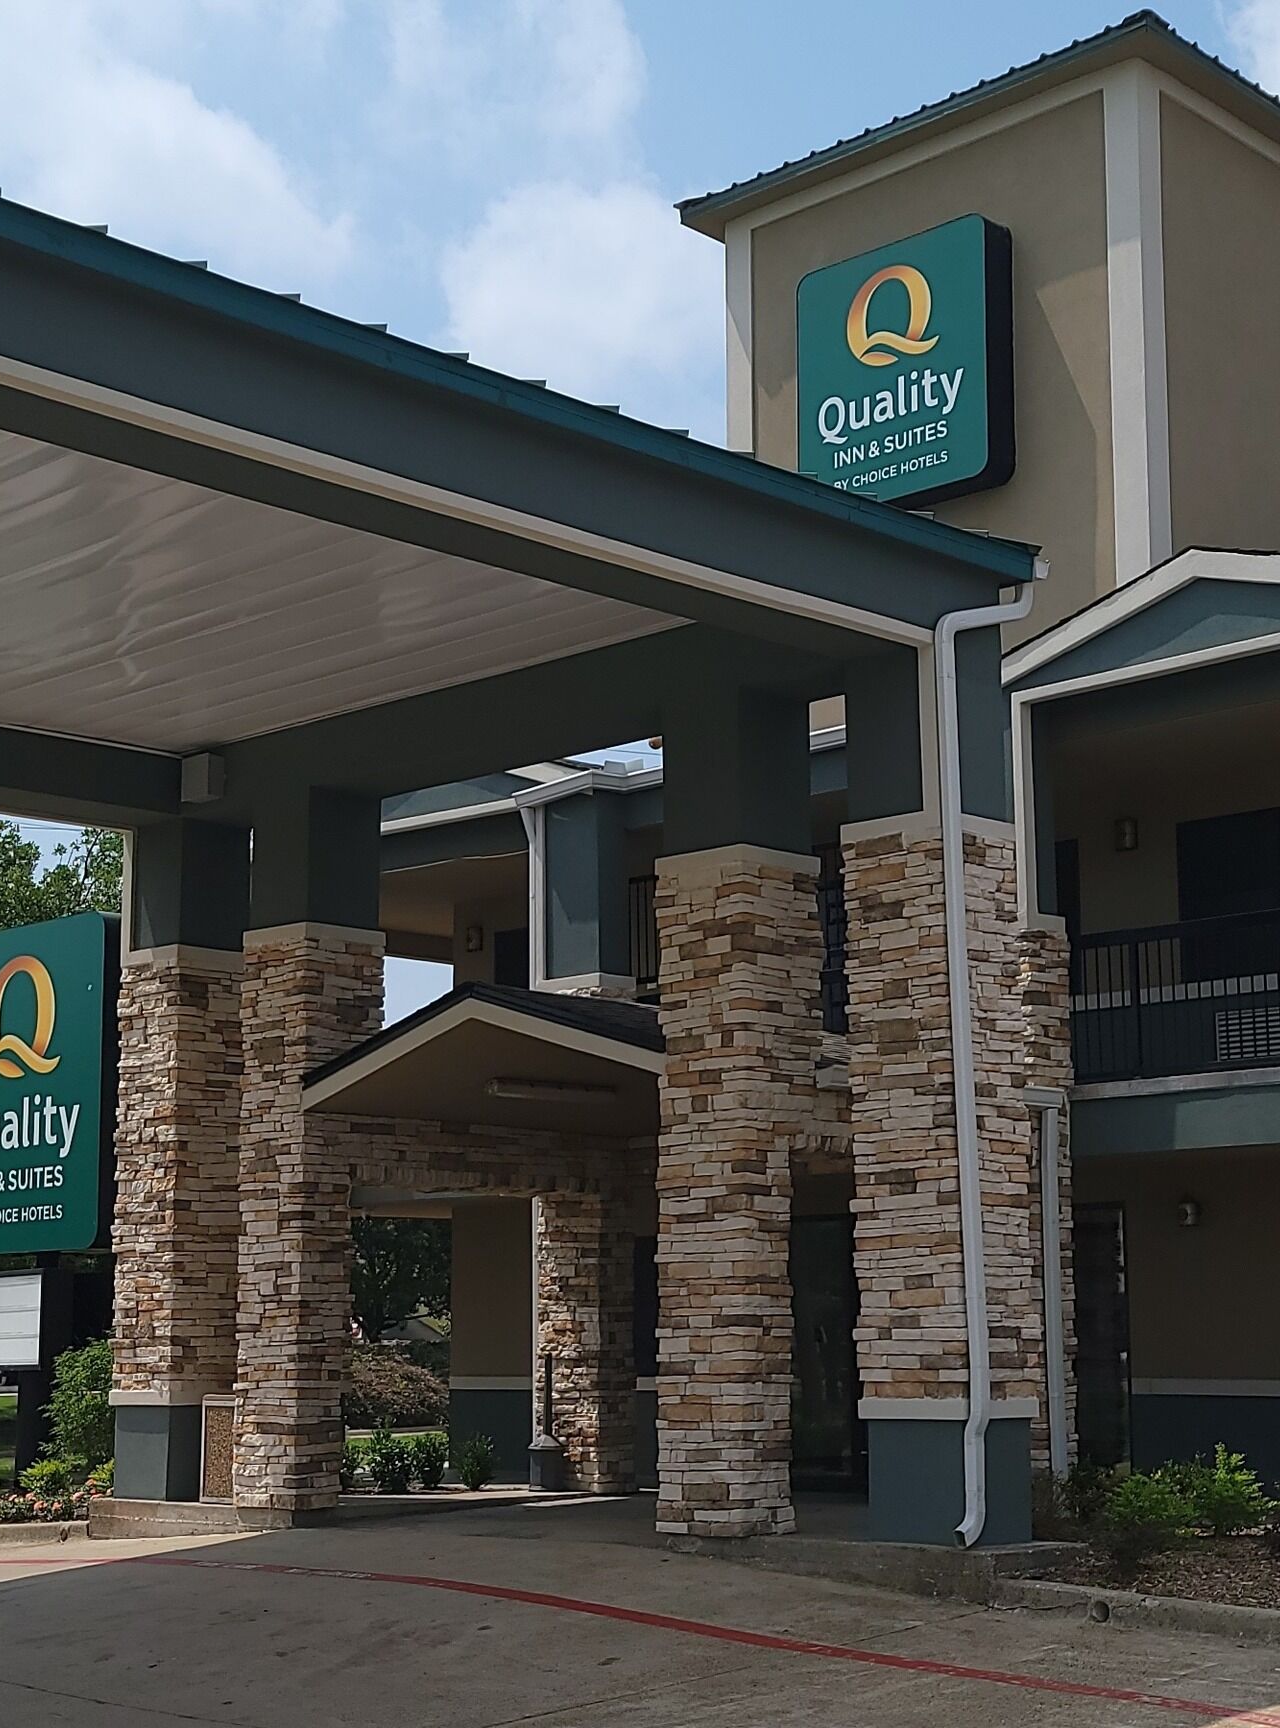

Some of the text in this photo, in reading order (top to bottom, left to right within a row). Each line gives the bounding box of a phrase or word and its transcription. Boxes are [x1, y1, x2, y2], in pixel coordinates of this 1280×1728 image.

[846, 264, 940, 367] Q
[817, 367, 965, 445] Quality
[833, 420, 949, 470] INN & SUITES
[833, 450, 948, 491] BY CHOICE HOTELS
[7, 1165, 64, 1192] SUITES
[21, 1203, 63, 1223] HOTELS
